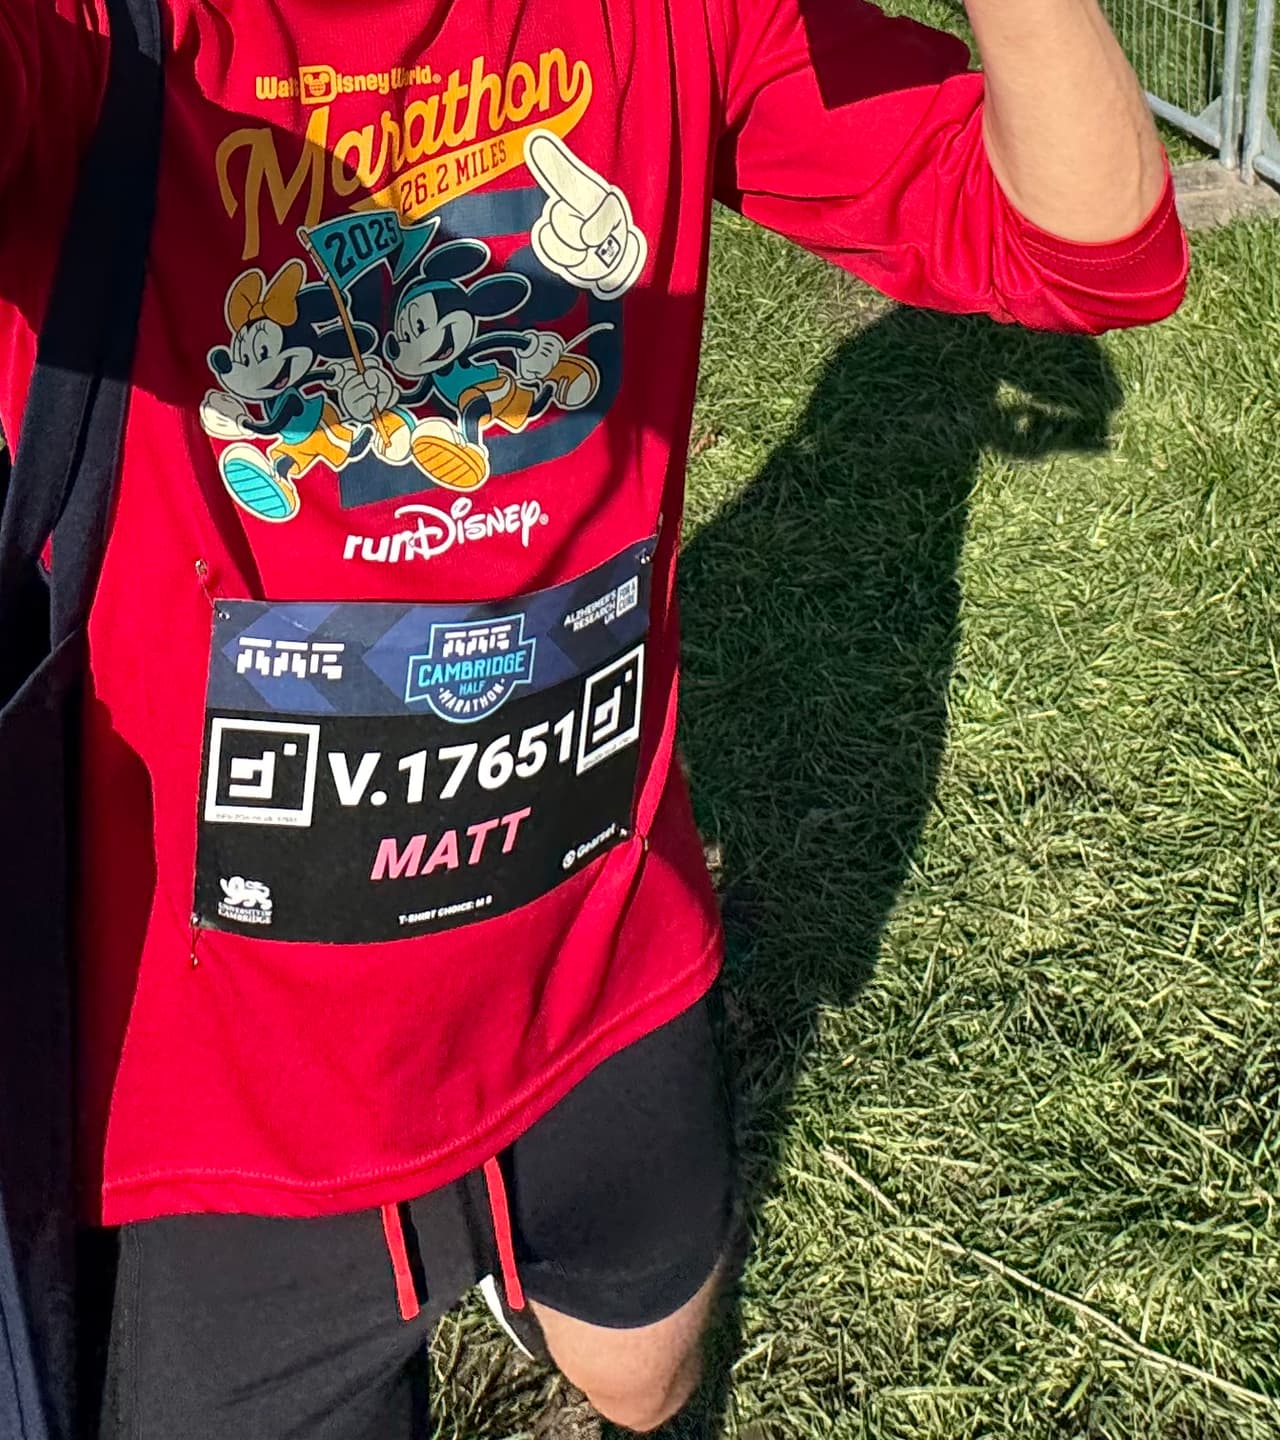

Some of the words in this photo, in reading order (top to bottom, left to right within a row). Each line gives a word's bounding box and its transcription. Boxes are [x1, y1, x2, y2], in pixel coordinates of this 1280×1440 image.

[299, 64, 391, 105] Disney
[215, 47, 592, 260] Marathon
[400, 169, 452, 214] 26.2
[453, 139, 508, 185] MILES
[324, 215, 400, 278] 2025
[418, 650, 527, 688] CAMBRIDGE
[438, 682, 505, 714] MARATHON
[459, 680, 487, 697] HALF
[327, 710, 576, 807] V.17651
[370, 806, 532, 881] MATT
